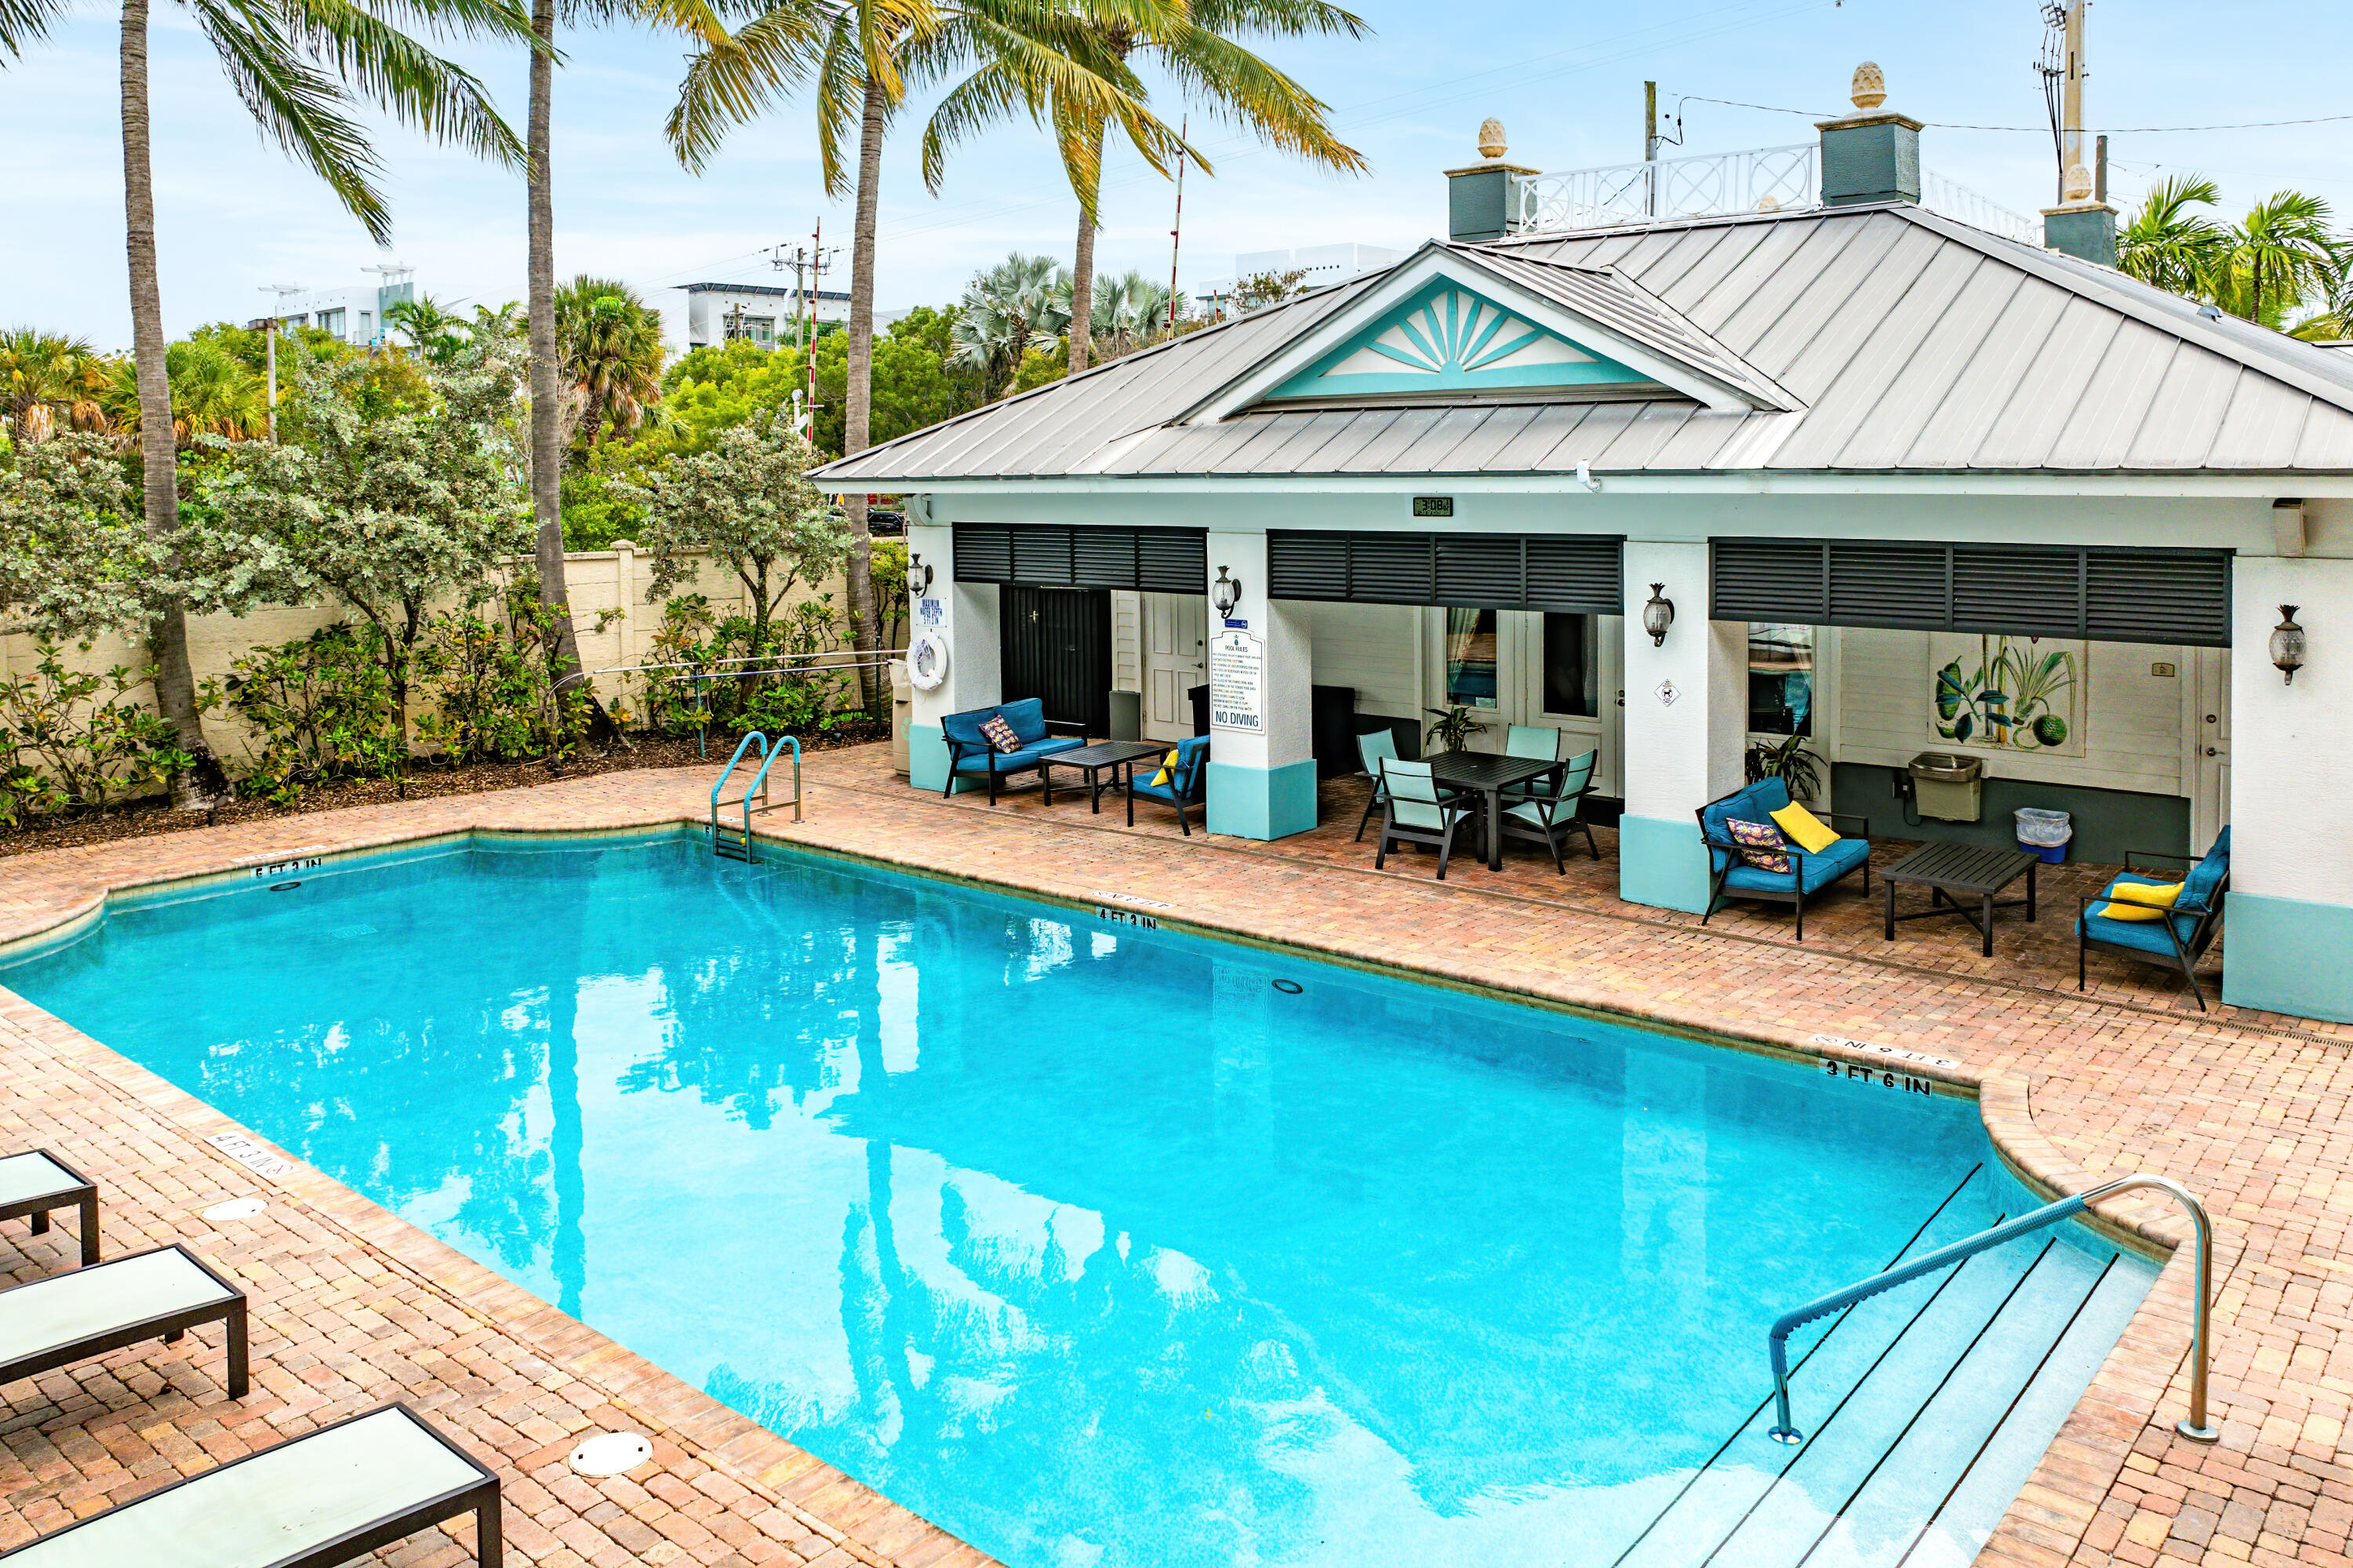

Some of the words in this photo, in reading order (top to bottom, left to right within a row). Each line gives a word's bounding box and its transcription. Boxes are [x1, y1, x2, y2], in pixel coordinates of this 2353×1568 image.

[1216, 711, 1227, 723] NO
[1230, 712, 1259, 727] DIVING
[269, 864, 285, 875] FT
[306, 857, 322, 868] IN
[1100, 908, 1106, 919] 4
[1111, 910, 1126, 923] FT
[1130, 914, 1136, 926] 3
[1142, 917, 1157, 930] IN
[1845, 1040, 1867, 1050] IN
[1827, 1060, 1838, 1076] 3
[1848, 1064, 1873, 1082] FT
[1883, 1072, 1894, 1088] 6
[1905, 1077, 1931, 1096] IN
[223, 1140, 252, 1151] FT
[239, 1150, 261, 1159] 3
[249, 1156, 278, 1168] IN
